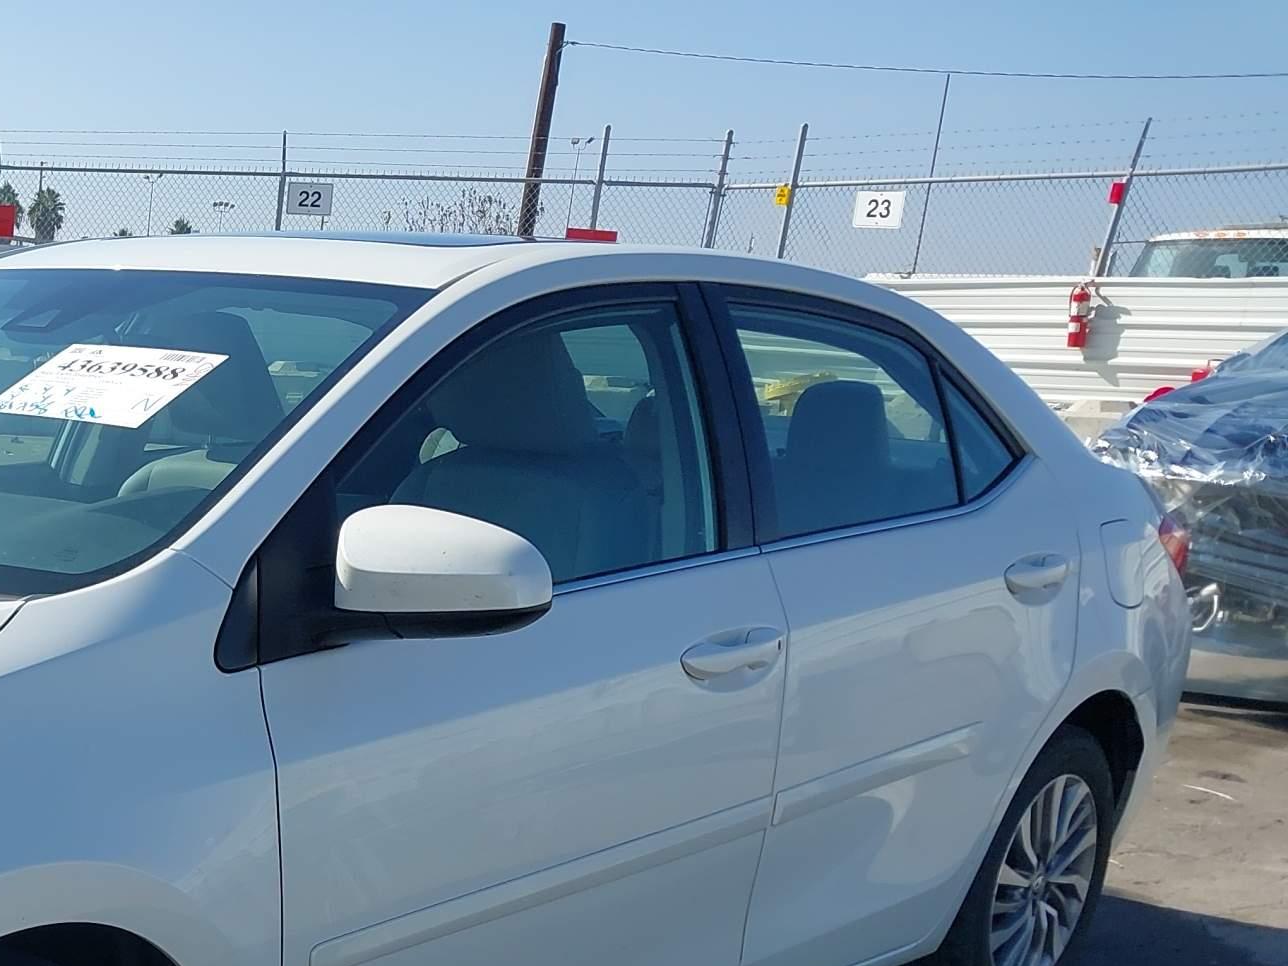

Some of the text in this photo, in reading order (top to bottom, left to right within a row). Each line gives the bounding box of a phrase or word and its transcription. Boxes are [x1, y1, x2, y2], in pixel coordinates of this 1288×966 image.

[298, 190, 322, 208] 22
[866, 198, 892, 218] 23
[58, 358, 186, 381] 43639588
